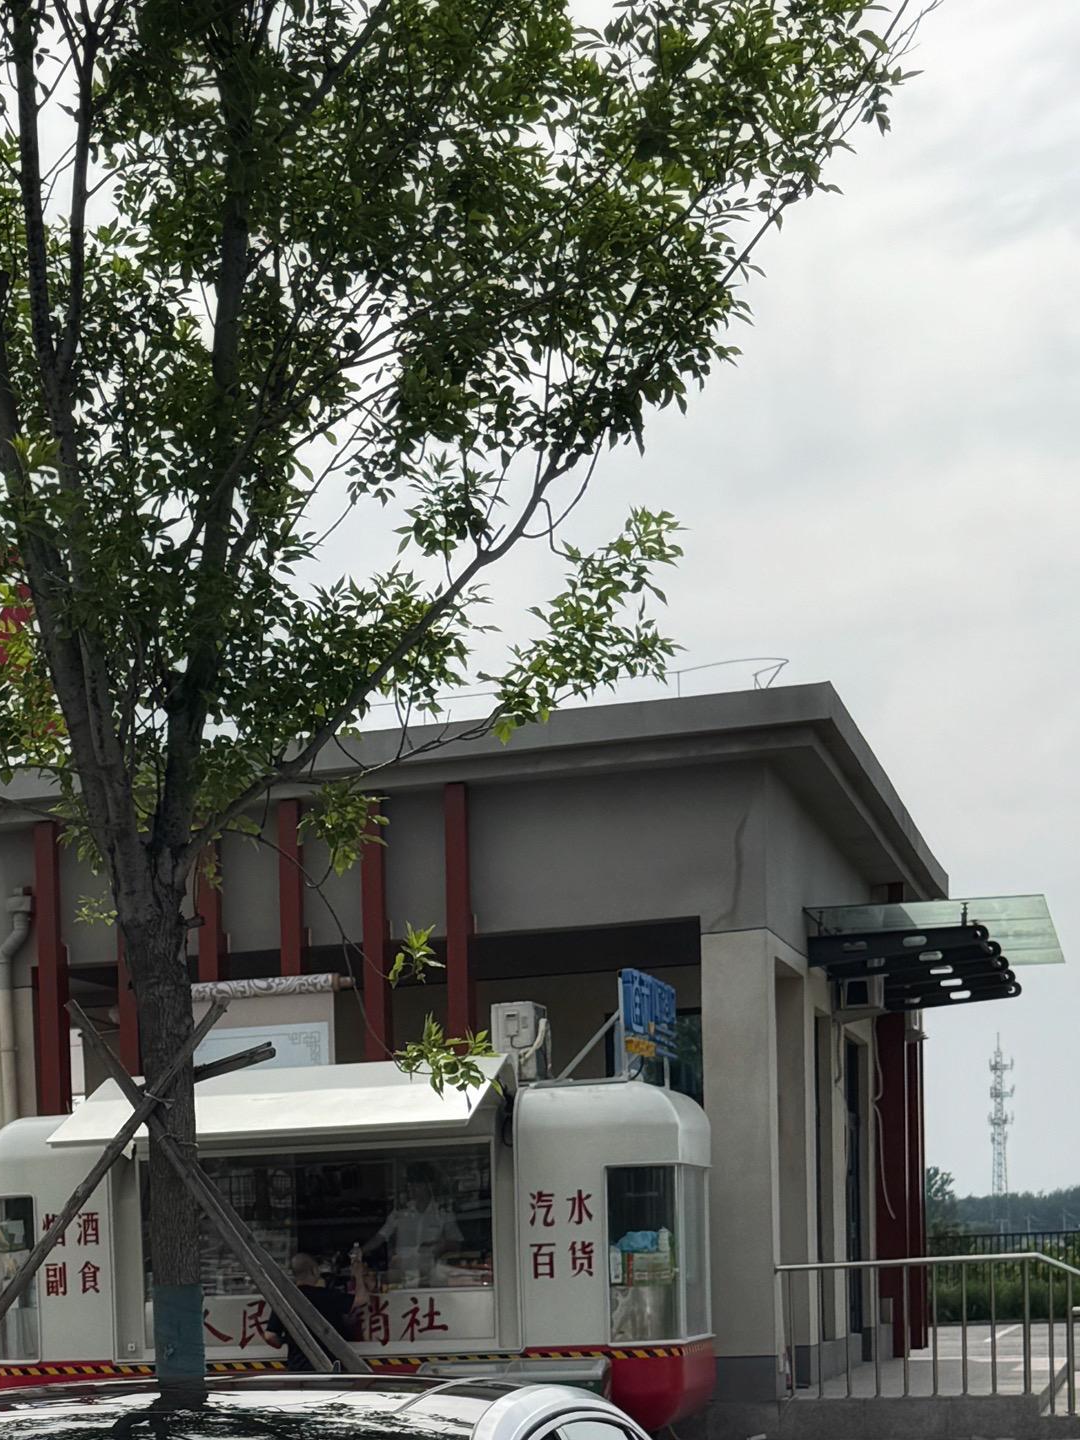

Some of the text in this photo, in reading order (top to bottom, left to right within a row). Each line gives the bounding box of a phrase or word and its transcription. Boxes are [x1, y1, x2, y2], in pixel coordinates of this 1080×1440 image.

[529, 1189, 593, 1228] 汽水
[43, 1261, 100, 1296] 副食
[529, 1241, 594, 1279] 百货
[203, 1295, 449, 1349] 民销社
